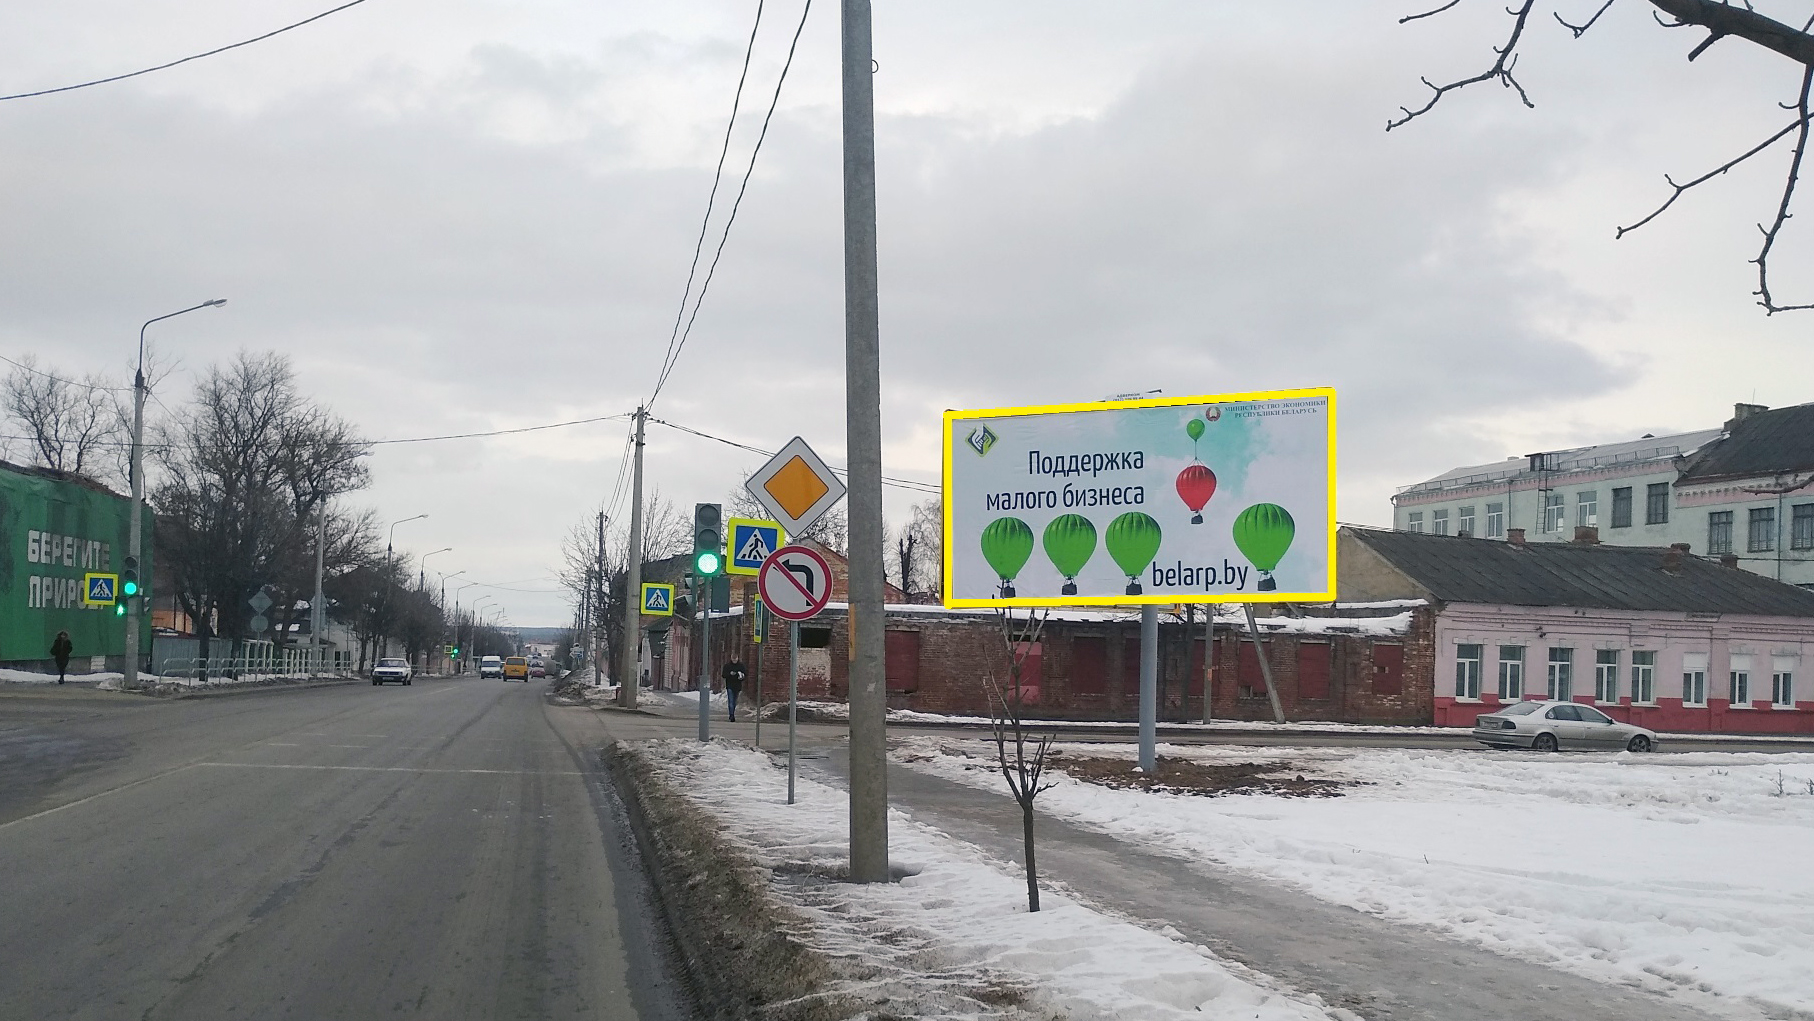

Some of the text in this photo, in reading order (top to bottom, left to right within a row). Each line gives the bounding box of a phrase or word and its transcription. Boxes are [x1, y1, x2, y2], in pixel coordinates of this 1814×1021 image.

[1282, 400, 1326, 408] ЭКОНОМИКИ
[1029, 450, 1144, 478] Поддержка
[986, 482, 1145, 511] малого бизнеса
[28, 529, 110, 571] БЕРЕГИТЕ
[1152, 558, 1249, 592] belarp.by
[28, 575, 104, 610] ПРИРО
